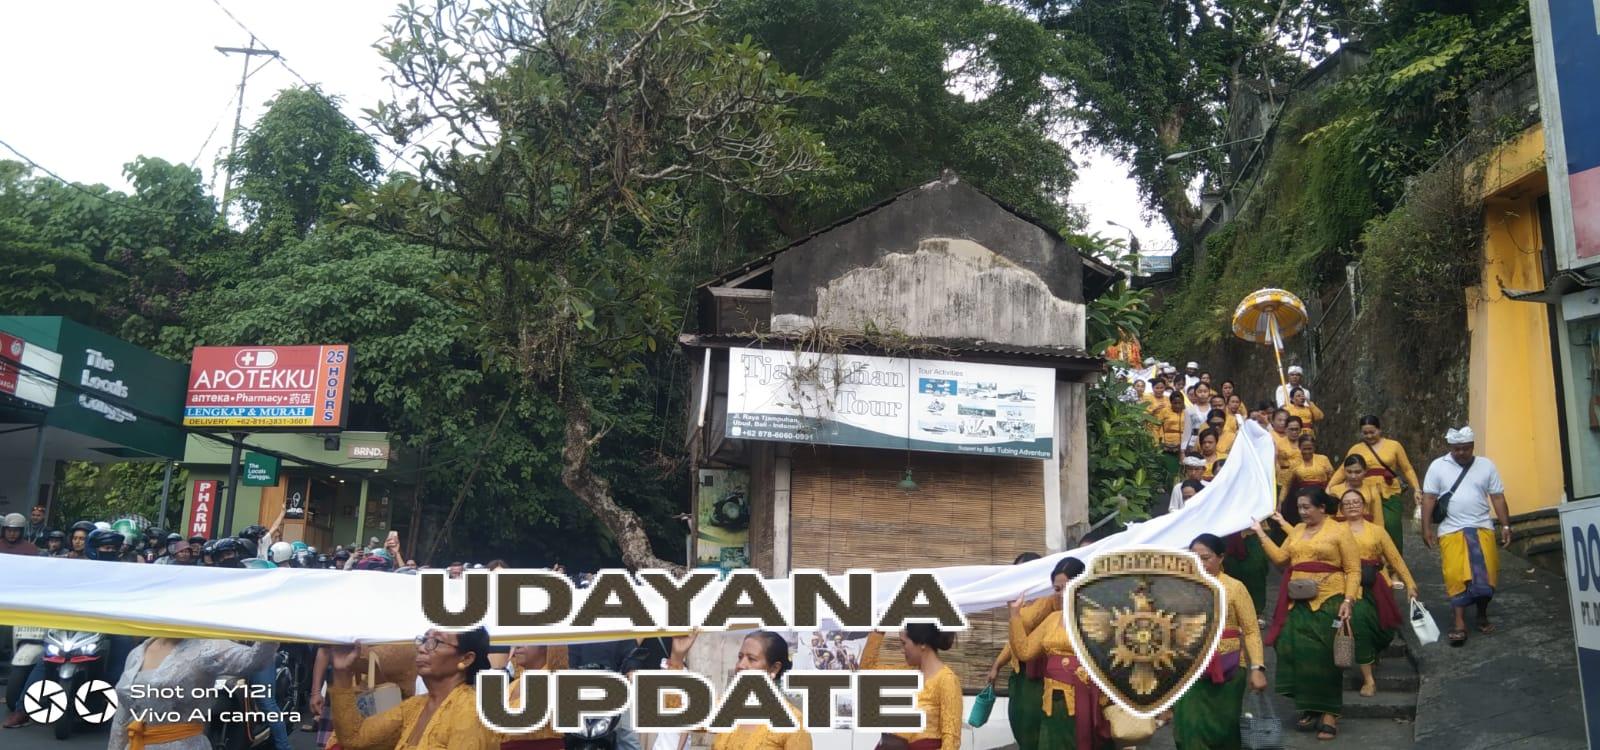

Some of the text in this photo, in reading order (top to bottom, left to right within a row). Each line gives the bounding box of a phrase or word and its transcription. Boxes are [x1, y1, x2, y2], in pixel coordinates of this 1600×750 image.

[85, 348, 115, 372] The
[193, 369, 315, 389] APOTEKKU
[918, 367, 963, 377] Tour Activities
[81, 369, 128, 398] Locals
[324, 351, 344, 421] 25 HOURS
[236, 392, 283, 405] Pharmacy
[835, 390, 903, 417] Tour
[187, 407, 306, 417] LENGKAP & MURAH
[997, 446, 1018, 456] Tubing
[1019, 448, 1051, 457] Adventure
